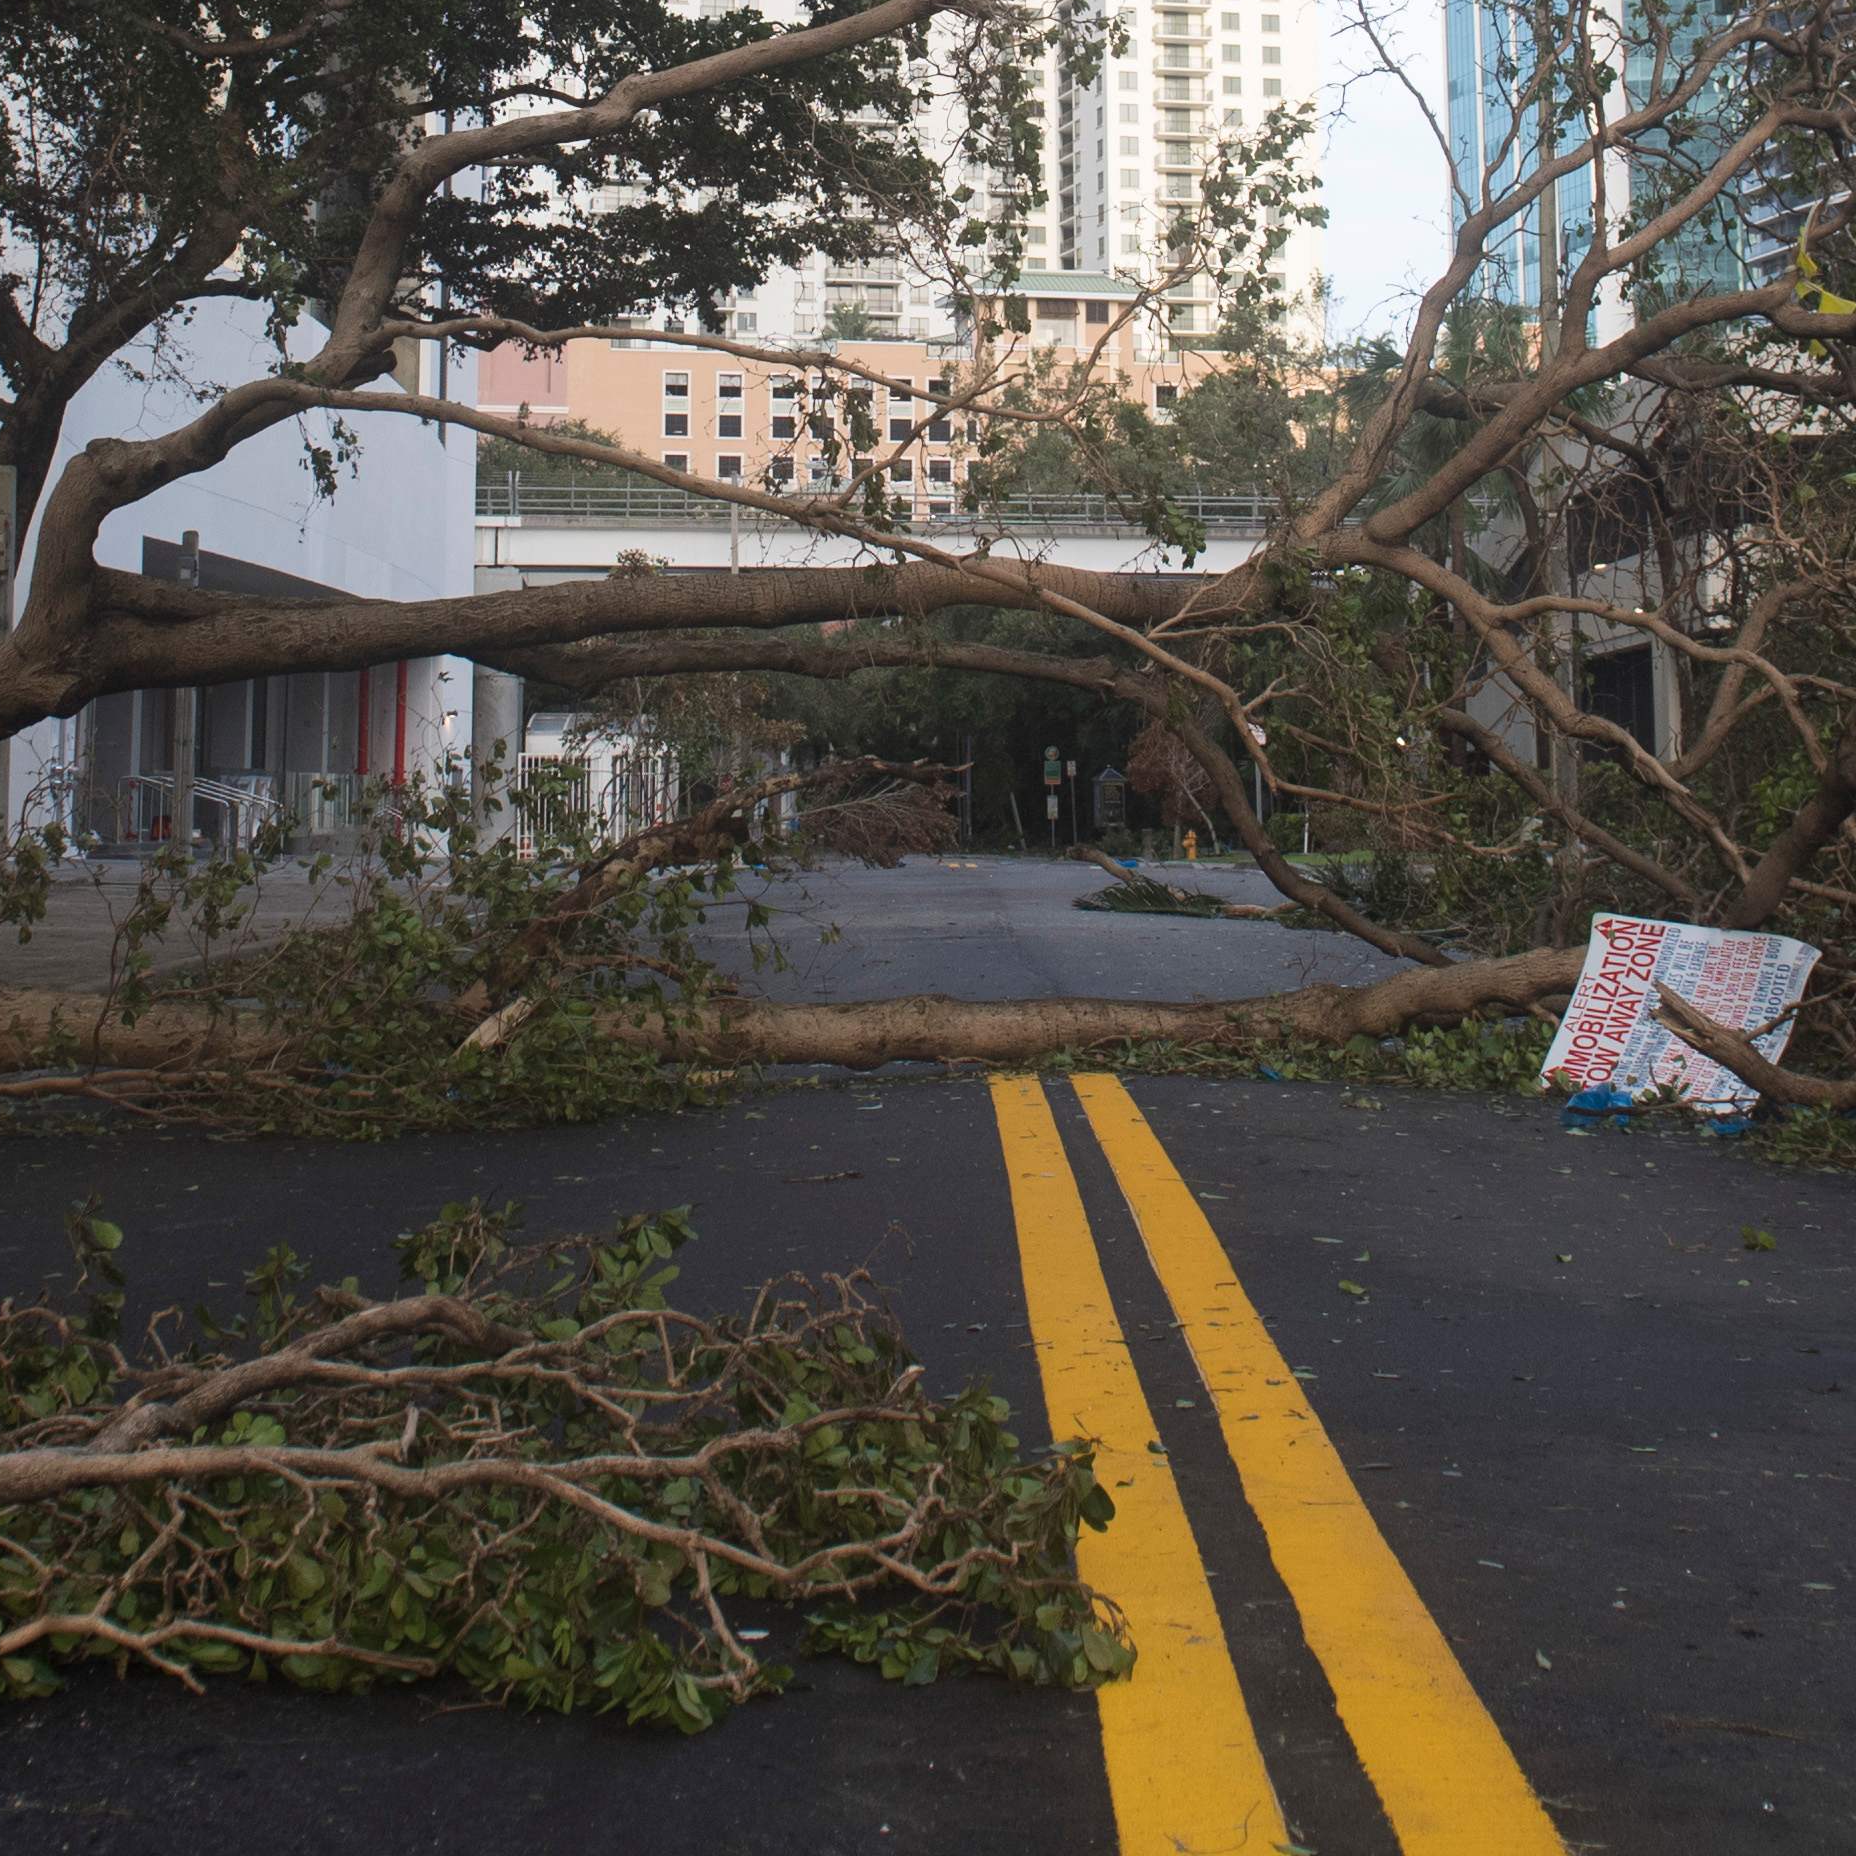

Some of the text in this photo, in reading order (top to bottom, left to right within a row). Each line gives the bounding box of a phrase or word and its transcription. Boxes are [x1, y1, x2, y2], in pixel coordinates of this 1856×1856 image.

[1651, 926, 1682, 980] NAUTHORIZED
[1677, 938, 1694, 950] BE
[1705, 944, 1721, 960] THE
[1734, 939, 1751, 955] FOR
[1745, 934, 1768, 970] EXPENSE
[1764, 936, 1782, 960] BOOT
[1671, 951, 1690, 971] WILL
[1710, 938, 1737, 985] IMMEDIATELY
[1730, 956, 1746, 969] FEE
[1762, 960, 1777, 968] A
[1698, 960, 1717, 981] LEAVE
[1602, 984, 1644, 1043] AWAY
[1624, 922, 1666, 981] ZONE
[1679, 978, 1697, 995] RISK
[1694, 982, 1710, 999] AND
[1739, 971, 1759, 993] YOUR
[1751, 969, 1775, 1003] REMOVE
[1557, 919, 1640, 1083] MMOBILIZATION
[1707, 987, 1723, 997] BE
[1736, 993, 1752, 1002] AT
[1563, 971, 1597, 1033] ALERT
[1700, 998, 1720, 1015] WILL
[1747, 1004, 1764, 1016] TO
